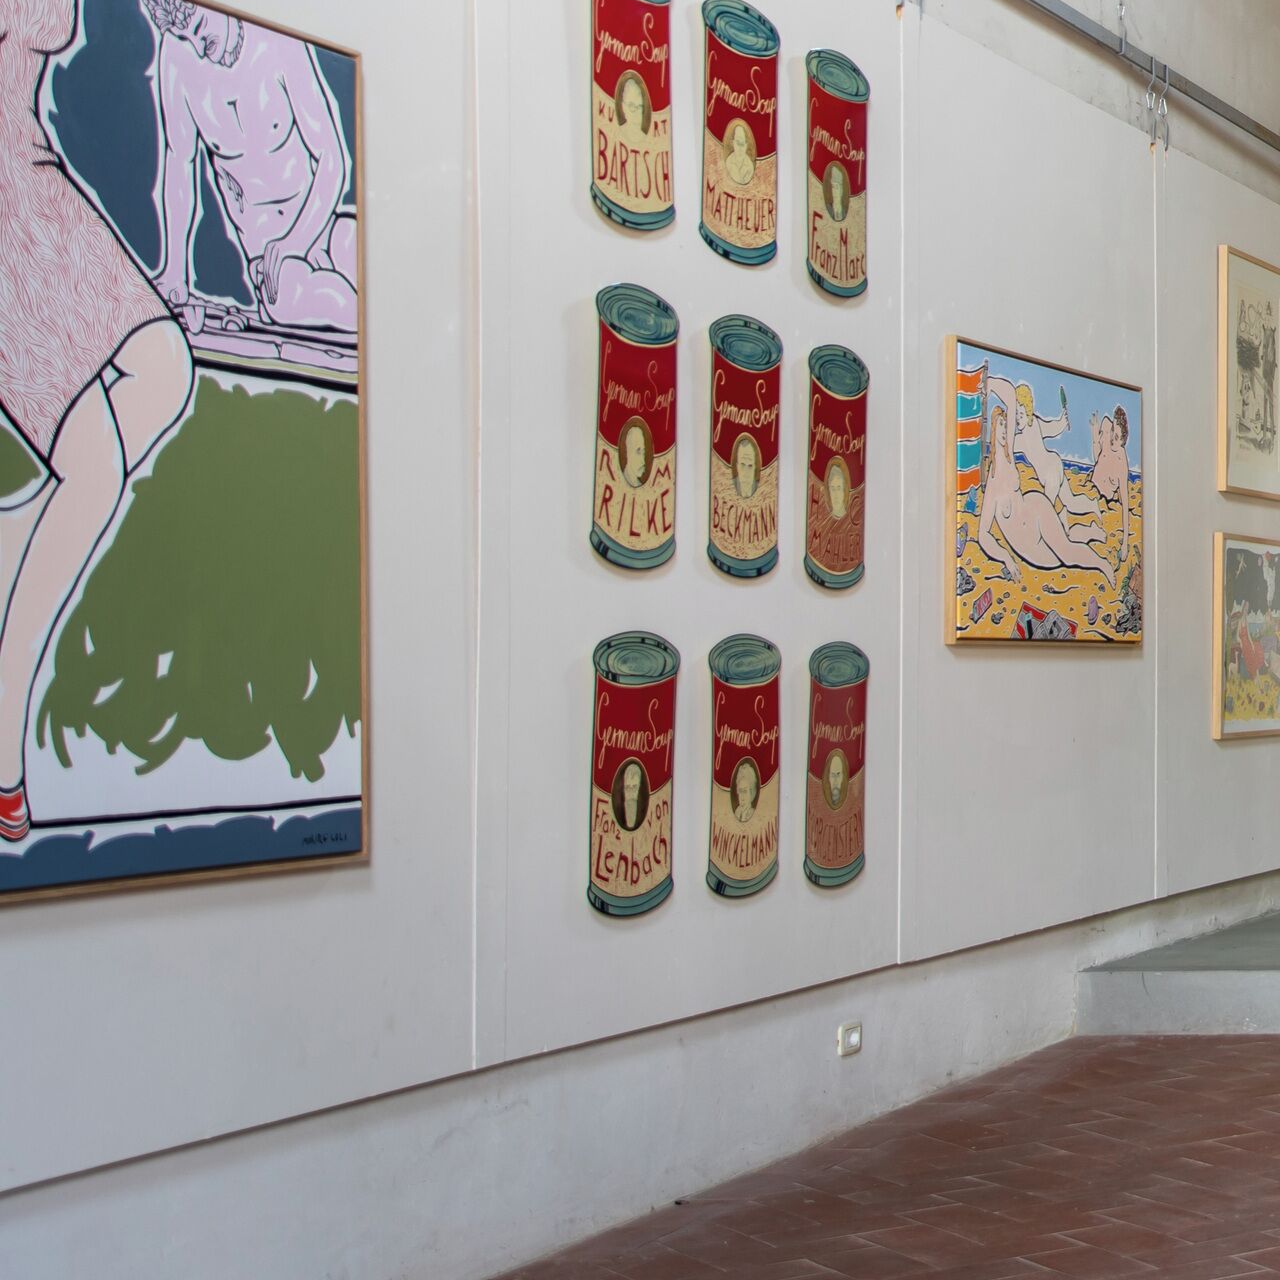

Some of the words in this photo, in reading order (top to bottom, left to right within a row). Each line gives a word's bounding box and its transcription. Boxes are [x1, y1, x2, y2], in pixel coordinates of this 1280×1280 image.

[641, 13, 668, 88] Soup
[707, 51, 746, 117] German
[745, 66, 776, 138] Soup
[597, 128, 671, 202] BARTSCH
[809, 97, 842, 161] German
[841, 119, 865, 186] Soup
[811, 210, 838, 280] Franz
[602, 340, 644, 422] German
[644, 361, 675, 431] Soup
[713, 369, 752, 443] German
[752, 379, 779, 442] Soup
[811, 394, 843, 461] German
[842, 411, 865, 465] Soup
[599, 484, 672, 536] RILKE
[713, 495, 776, 543] BECKMANN
[597, 692, 646, 769] German
[644, 698, 673, 772] Soup
[715, 691, 751, 770] German
[751, 695, 778, 765] Soup
[596, 822, 668, 886] Lenbach
